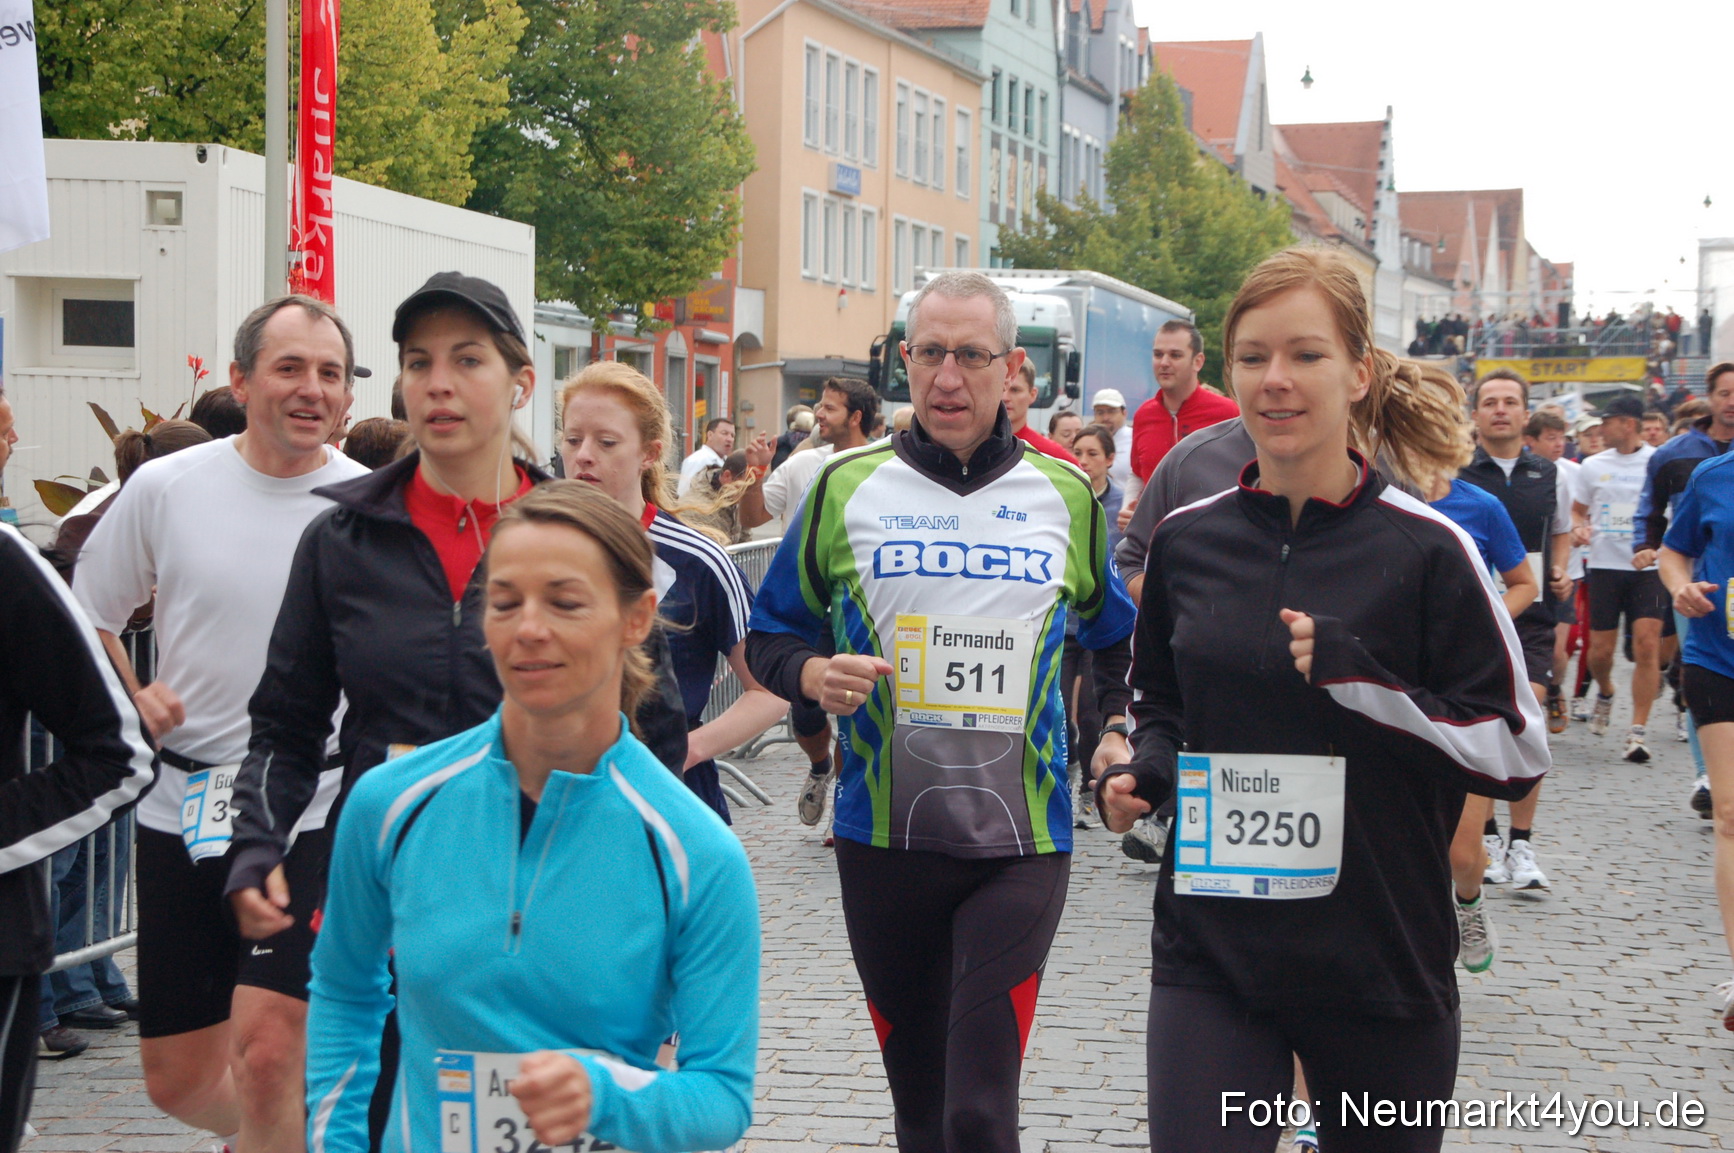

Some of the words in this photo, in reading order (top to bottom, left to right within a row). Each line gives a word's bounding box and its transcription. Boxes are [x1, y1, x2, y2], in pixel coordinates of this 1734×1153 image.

[303, 66, 334, 300] Sparka
[1530, 362, 1588, 376] START
[879, 515, 959, 530] TEAM
[873, 540, 1053, 585] BOCK
[933, 625, 1014, 651] Fernando
[900, 657, 909, 673] C
[945, 661, 1005, 695] 511
[978, 713, 1023, 726] PFLEIDERER
[1221, 767, 1280, 794] Nicole
[1188, 806, 1197, 824] C
[1225, 809, 1321, 848] 3250
[1271, 876, 1336, 890] PFLEIDERER
[450, 1112, 460, 1134] C
